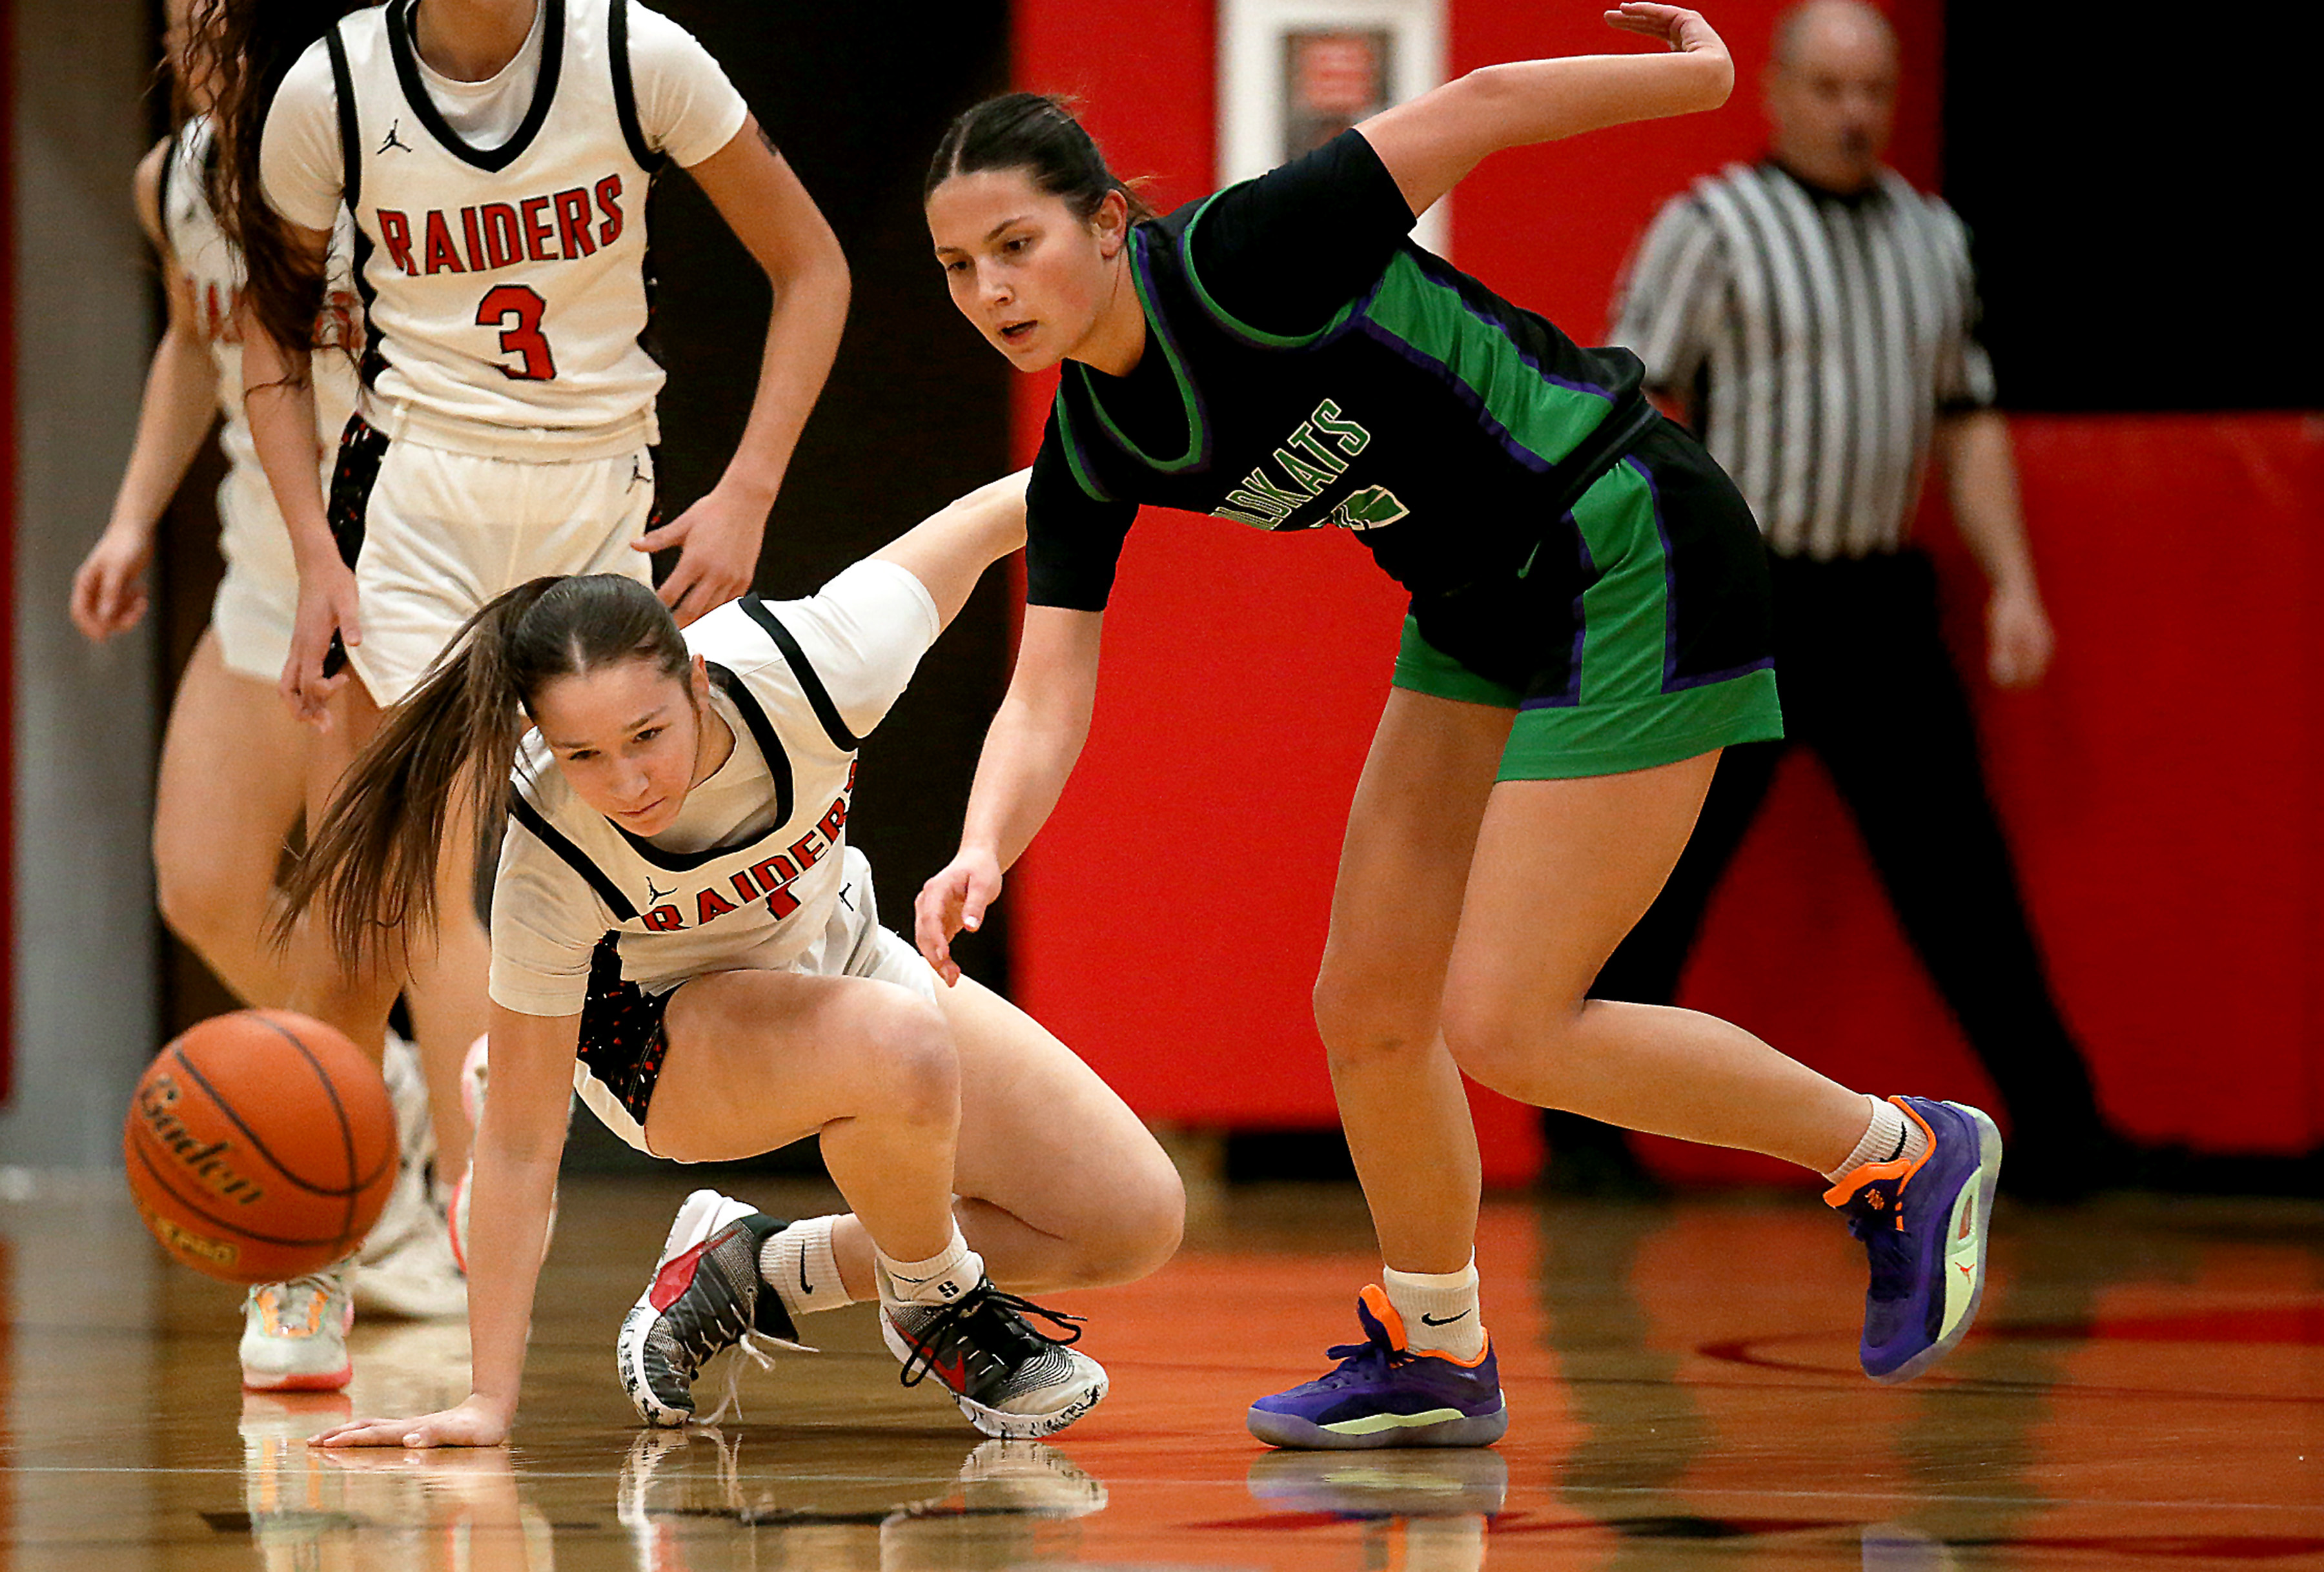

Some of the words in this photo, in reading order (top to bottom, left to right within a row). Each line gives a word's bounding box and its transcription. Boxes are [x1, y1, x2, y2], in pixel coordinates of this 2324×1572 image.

[377, 173, 623, 276] RAIDERS
[475, 283, 556, 381] 3
[641, 759, 857, 932] RAIDER
